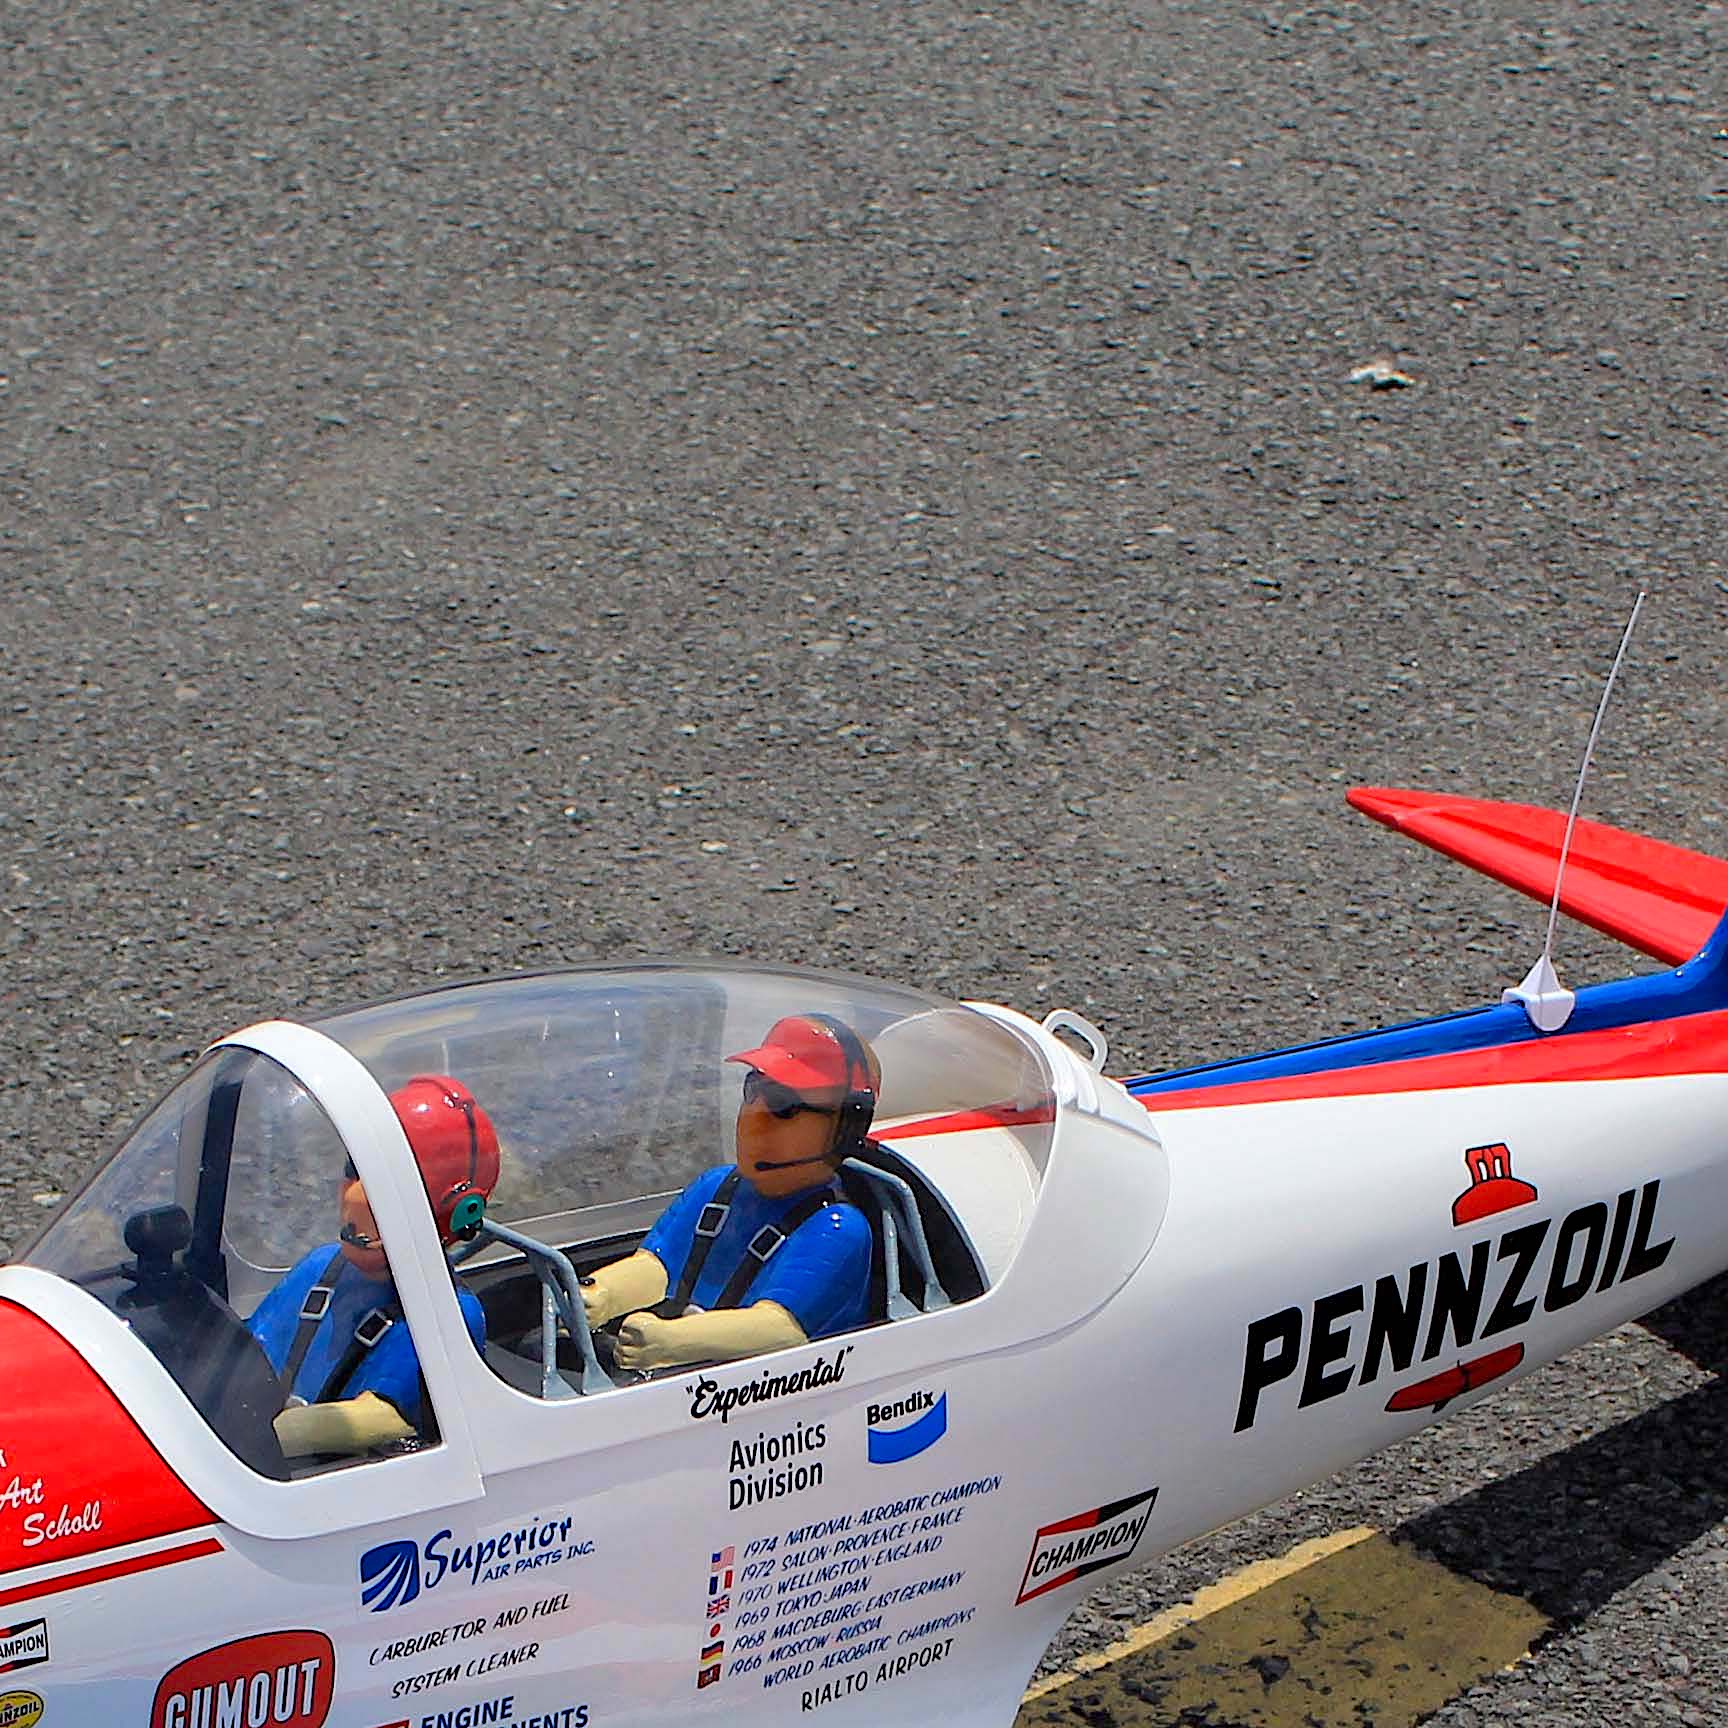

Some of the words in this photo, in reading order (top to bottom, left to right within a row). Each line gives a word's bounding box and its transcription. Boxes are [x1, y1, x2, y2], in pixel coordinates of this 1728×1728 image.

[1233, 1178, 1675, 1434] PENNZOIL
[866, 1391, 935, 1425] Bendix
[729, 1422, 826, 1473] Avionics
[729, 1461, 823, 1511] Division
[22, 1499, 103, 1547] Scholl
[743, 1535, 779, 1559] 1974
[931, 1475, 1002, 1508] CHAMPION
[424, 1516, 573, 1590] Superior
[482, 1563, 511, 1584] AIR
[514, 1549, 563, 1575] PARTS
[741, 1559, 776, 1583] 1972
[1031, 1515, 1145, 1578] CHAMPION
[734, 1605, 770, 1630] 1969
[737, 1583, 773, 1606] 1970
[369, 1617, 487, 1666] CARBURETOR
[493, 1606, 528, 1630] AND
[531, 1593, 572, 1619] FUEL
[731, 1629, 767, 1654] 1968
[465, 1642, 540, 1678] CLEANER
[727, 1654, 763, 1678] 1966
[763, 1660, 815, 1689] WORLD
[818, 1635, 892, 1671] AEROBATIC
[801, 1670, 869, 1713] RIALTO
[875, 1638, 954, 1684] AIRPORT
